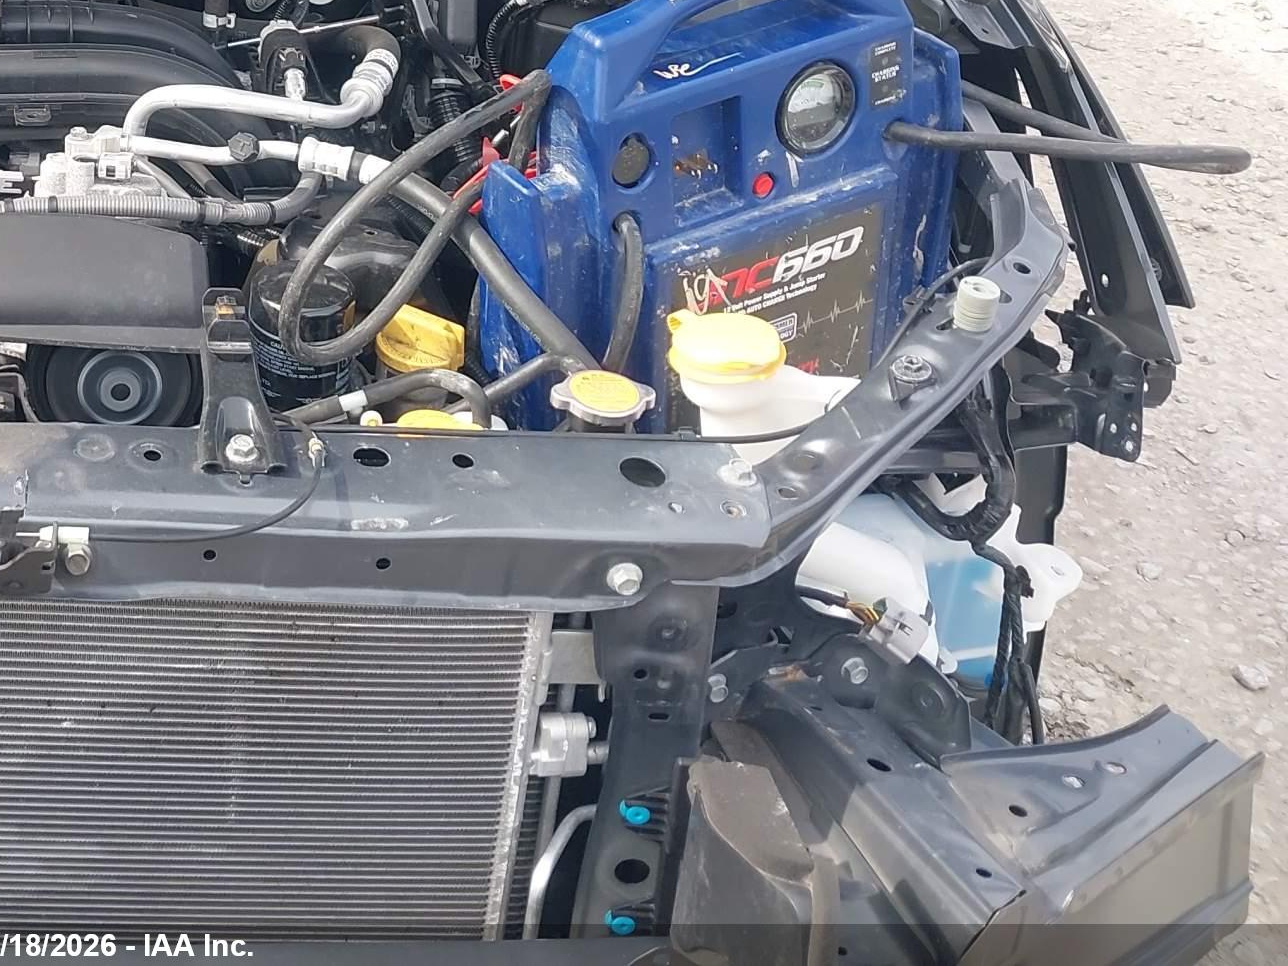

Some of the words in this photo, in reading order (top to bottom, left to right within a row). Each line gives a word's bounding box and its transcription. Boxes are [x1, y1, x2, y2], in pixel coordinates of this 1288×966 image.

[744, 296, 762, 307] Power
[763, 288, 783, 301] Supply
[789, 280, 805, 291] Jump
[806, 273, 826, 284] Starter
[746, 305, 762, 314] AUTO
[786, 284, 818, 300] Technology
